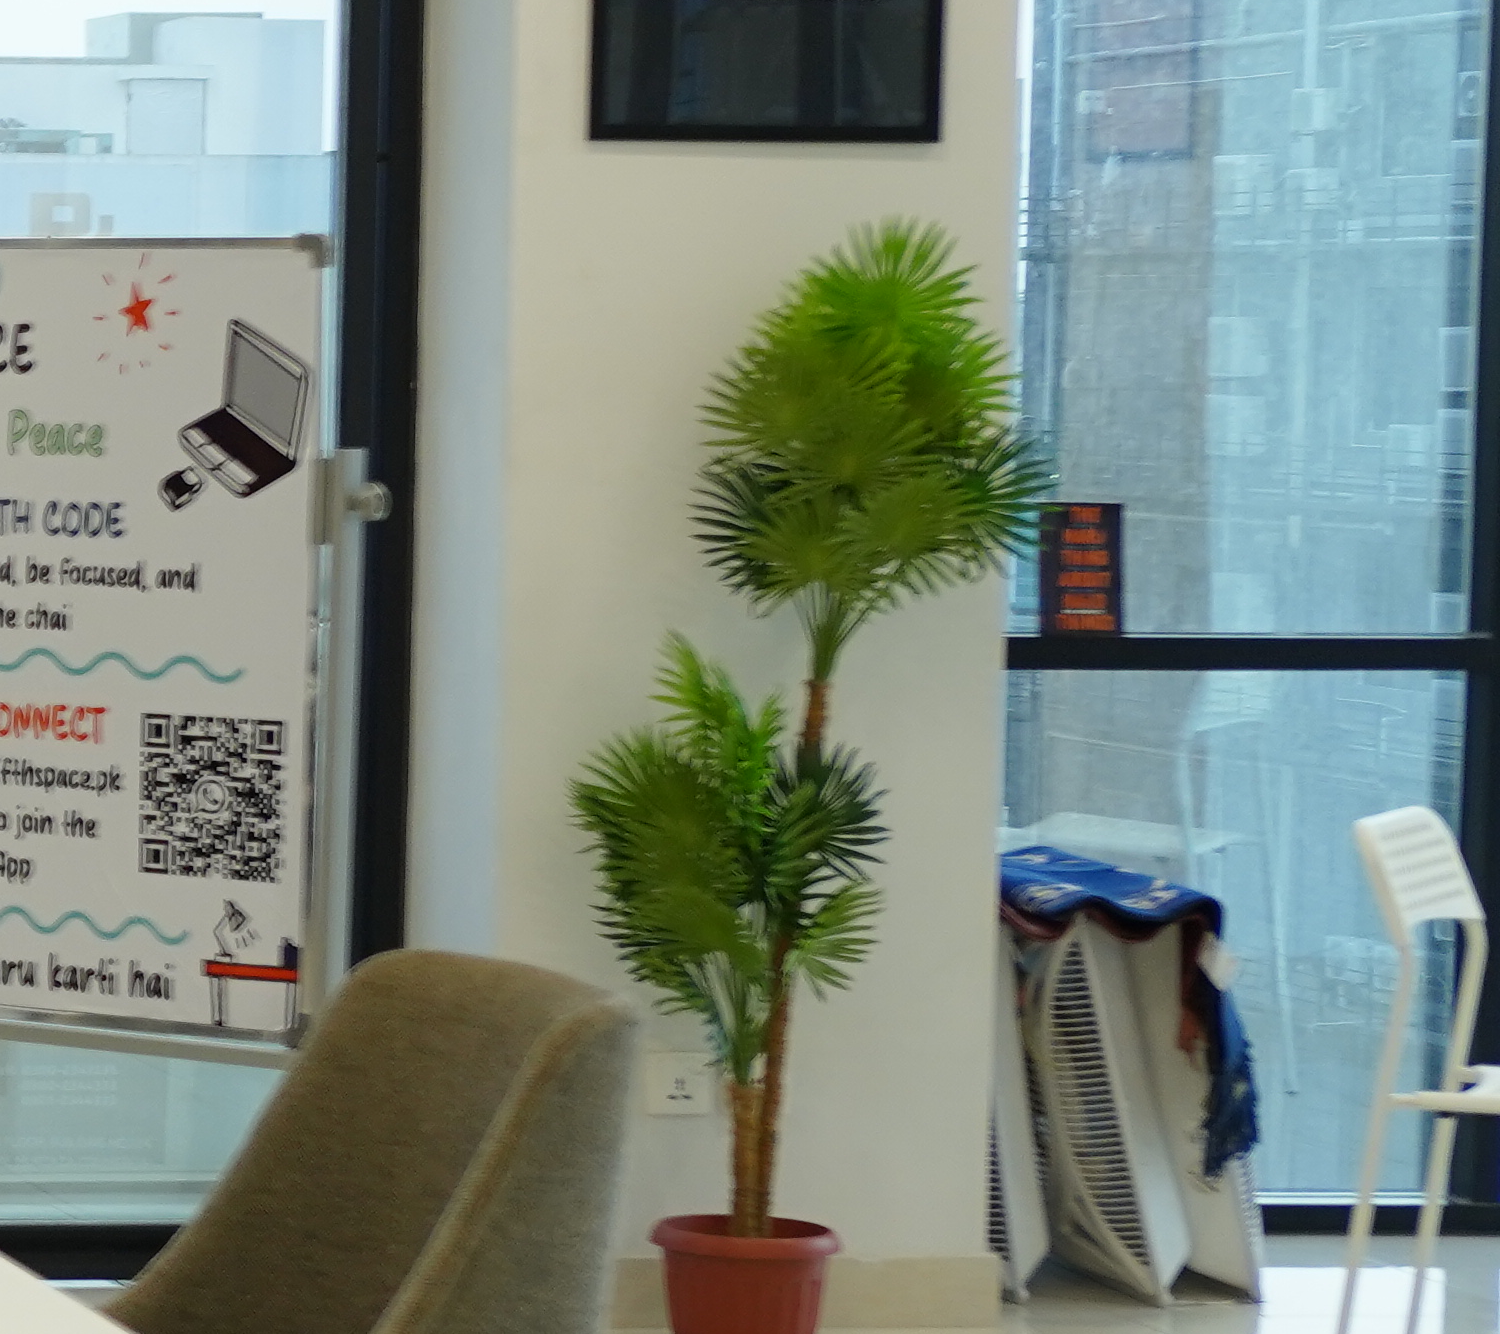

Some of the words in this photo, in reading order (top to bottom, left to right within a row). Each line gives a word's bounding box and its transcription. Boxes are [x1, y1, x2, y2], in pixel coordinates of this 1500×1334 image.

[5, 409, 108, 458] Peace
[41, 500, 126, 539] CODE
[25, 556, 51, 584] be
[153, 562, 197, 592] and
[24, 602, 68, 631] chai
[14, 805, 53, 840] join
[61, 809, 97, 839] the
[47, 952, 117, 996] karti
[126, 957, 176, 1003] hai
